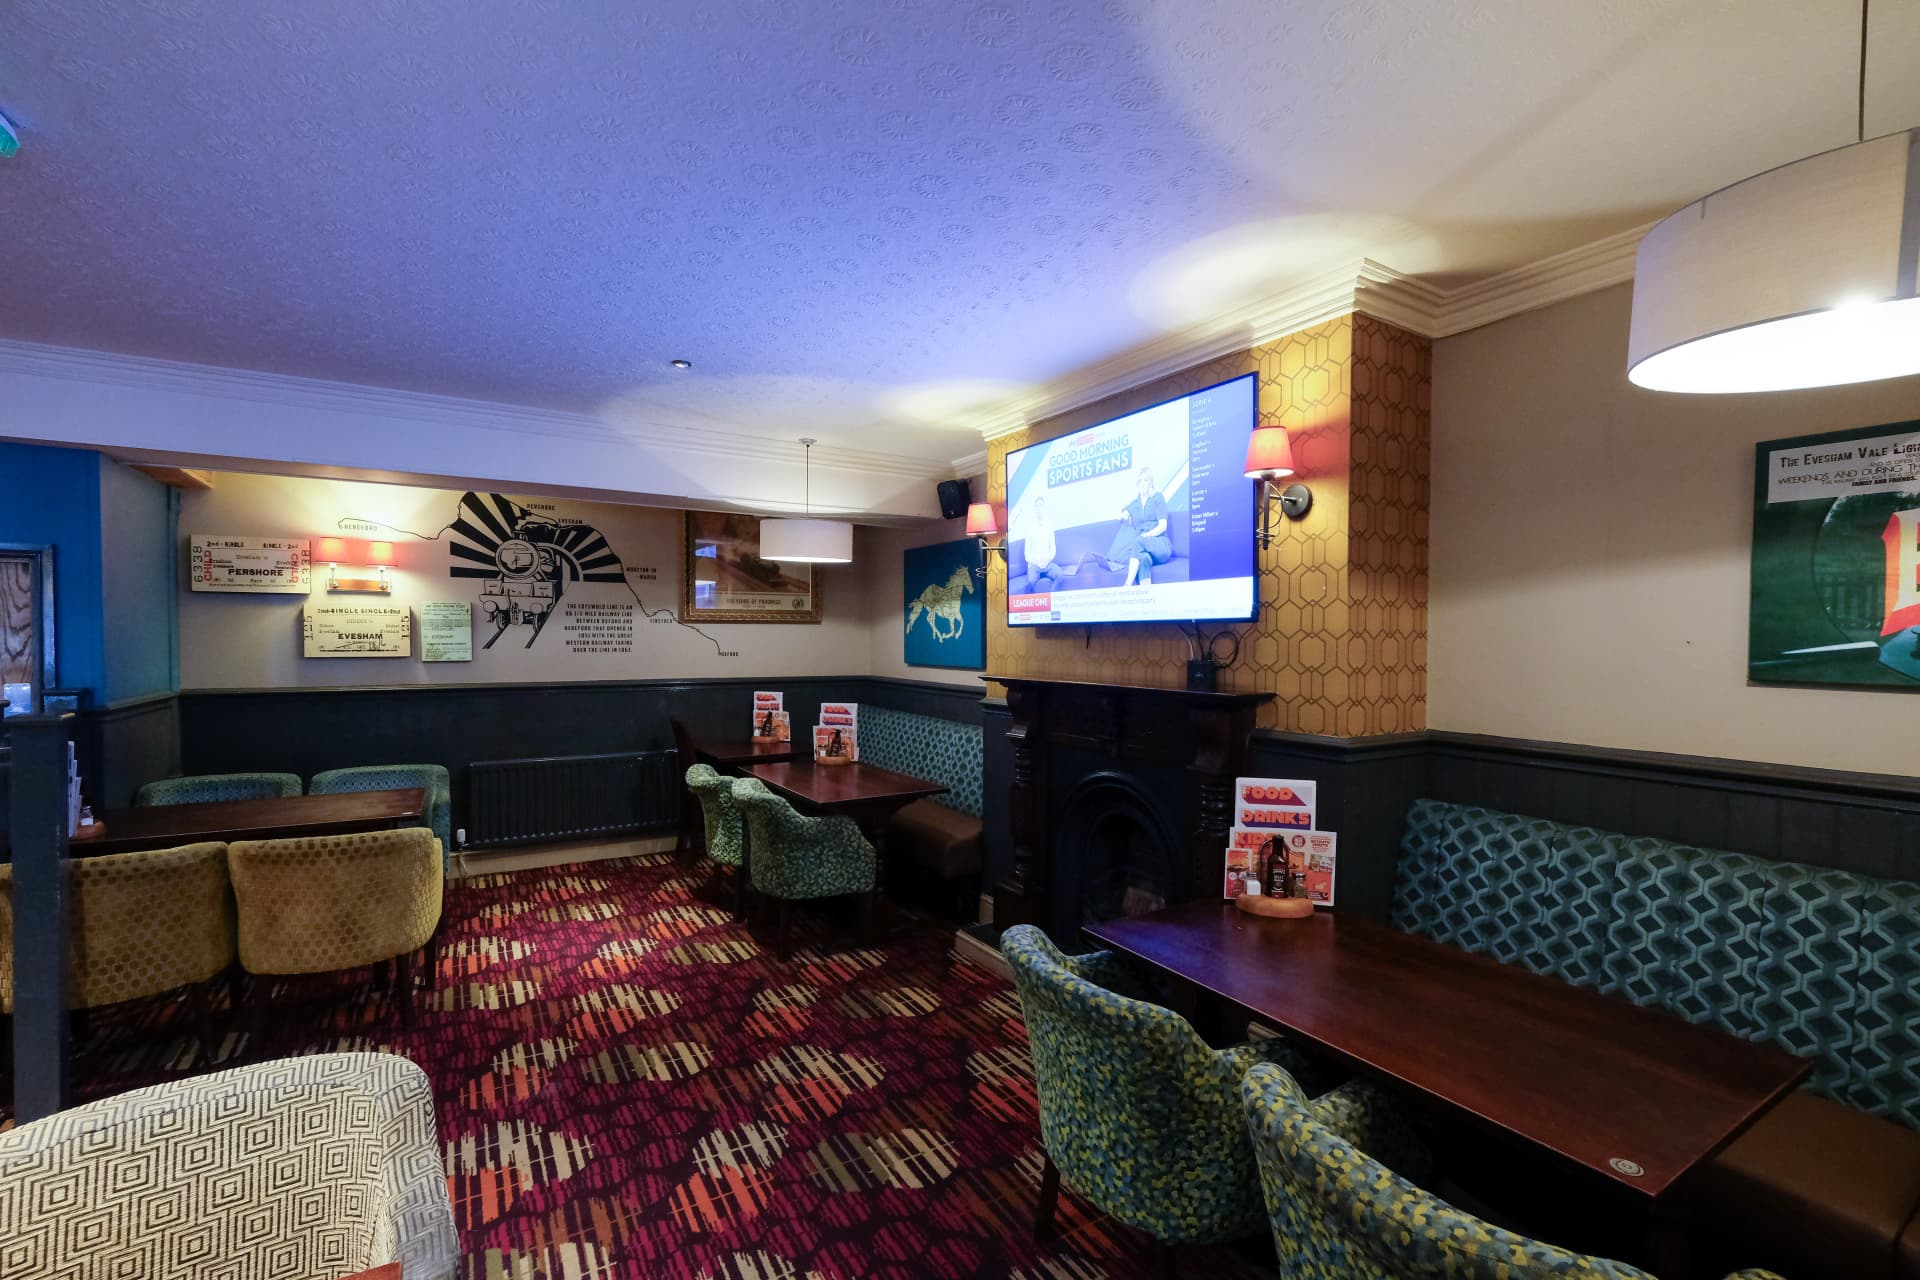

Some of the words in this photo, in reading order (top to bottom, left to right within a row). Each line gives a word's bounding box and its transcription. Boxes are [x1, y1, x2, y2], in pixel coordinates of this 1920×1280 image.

[1050, 451, 1077, 467] GOOD
[1080, 434, 1129, 459] MORNING
[1804, 452, 1852, 465] EVESHAM
[1858, 446, 1888, 458] VALE
[1050, 464, 1092, 486] SPORTS
[1096, 451, 1129, 474] FANS
[1778, 472, 1830, 484] WEEKENDS
[1834, 469, 1858, 479] AND
[1862, 464, 1902, 476] DURING
[193, 546, 203, 582] 6338
[204, 550, 212, 582] CHILD
[228, 568, 284, 576] PERSHORE
[1014, 598, 1034, 608] LEAGUE
[1035, 597, 1048, 606] ONE
[304, 616, 313, 640] 125
[401, 616, 410, 640] 125
[1242, 785, 1293, 801] FOOD
[1241, 810, 1310, 826] DRINKS
